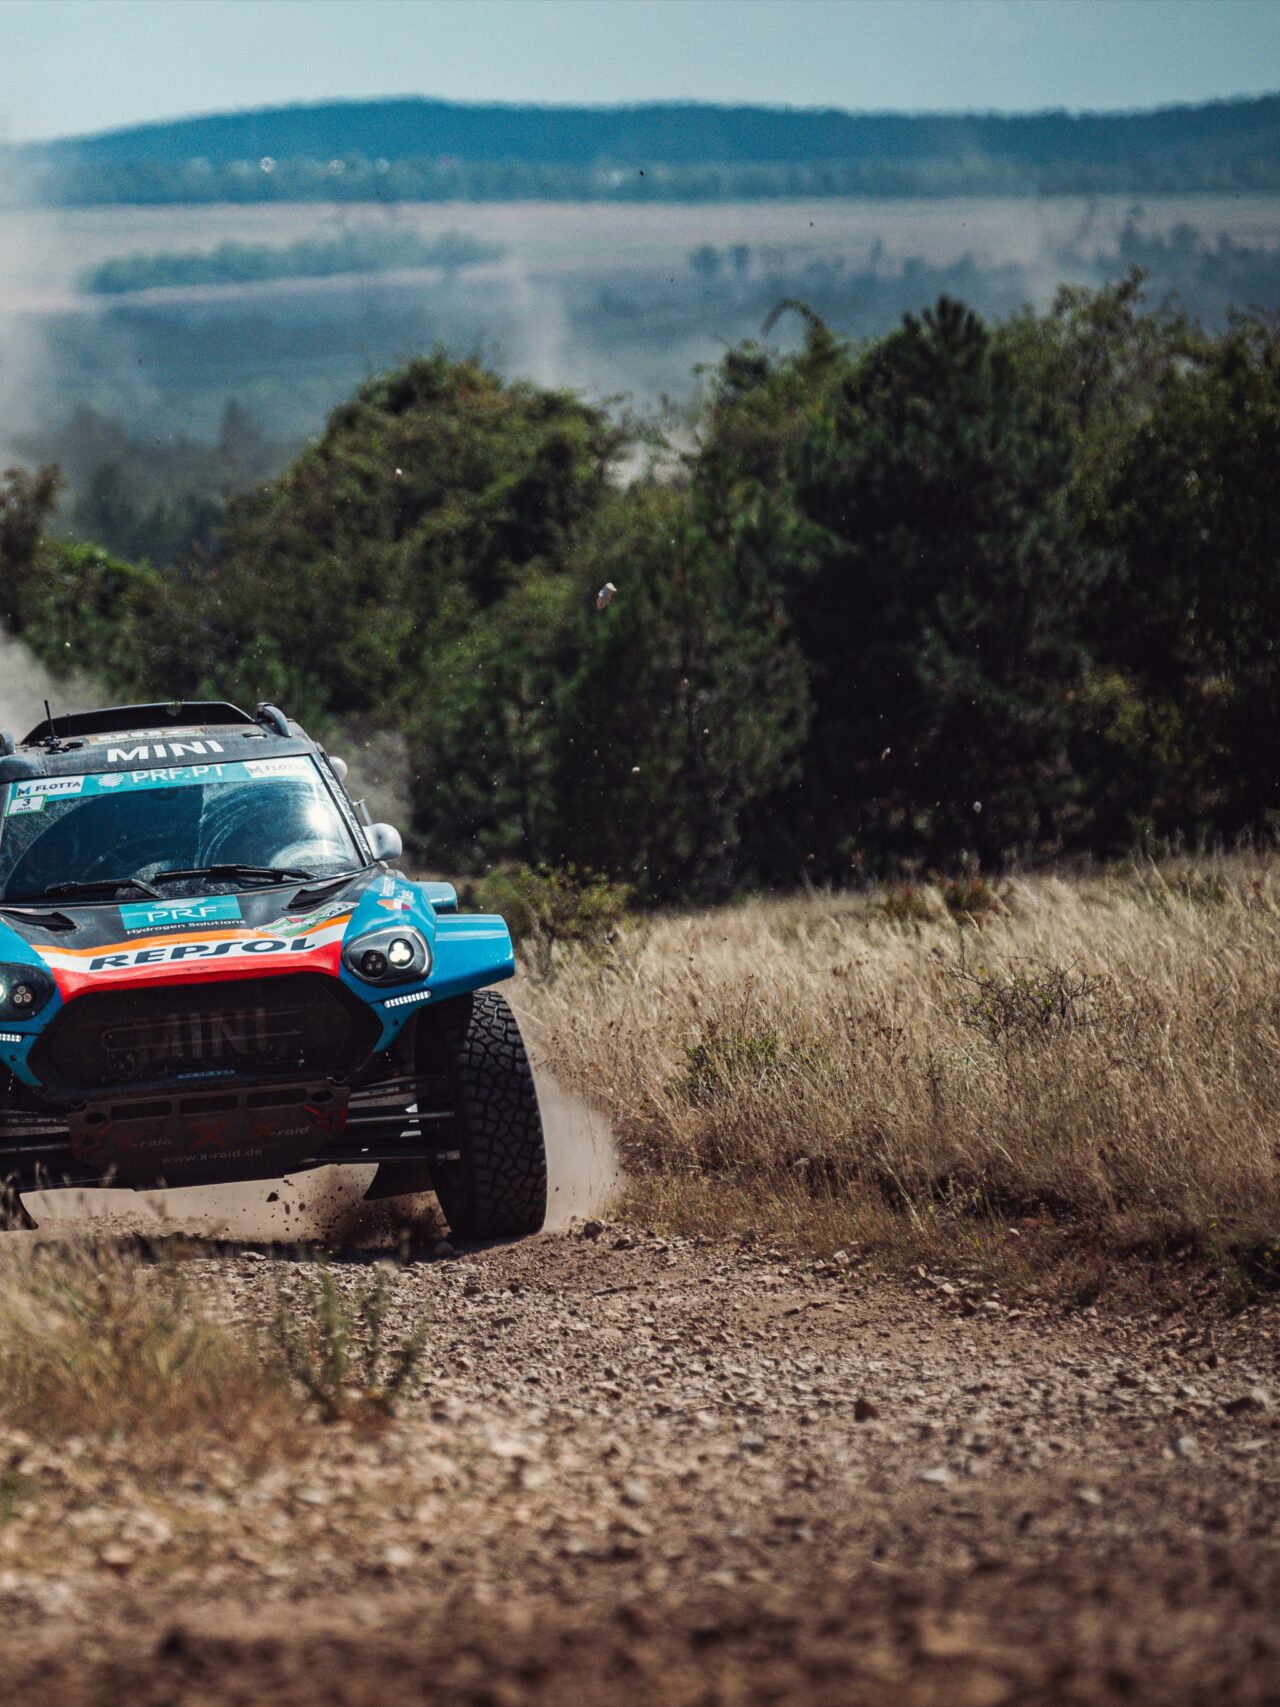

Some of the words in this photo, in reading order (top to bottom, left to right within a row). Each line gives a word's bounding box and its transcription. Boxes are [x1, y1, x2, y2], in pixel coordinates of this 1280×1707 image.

[107, 740, 225, 762] MINI
[131, 764, 227, 783] PRF.PT
[35, 781, 81, 792] FLOTTA
[22, 798, 31, 806] 3
[147, 906, 217, 922] PRF
[126, 924, 186, 935] Hydrogen
[188, 919, 247, 928] Solutions
[89, 938, 316, 971] REPSOL
[161, 1148, 263, 1165] www.x-raid.de
